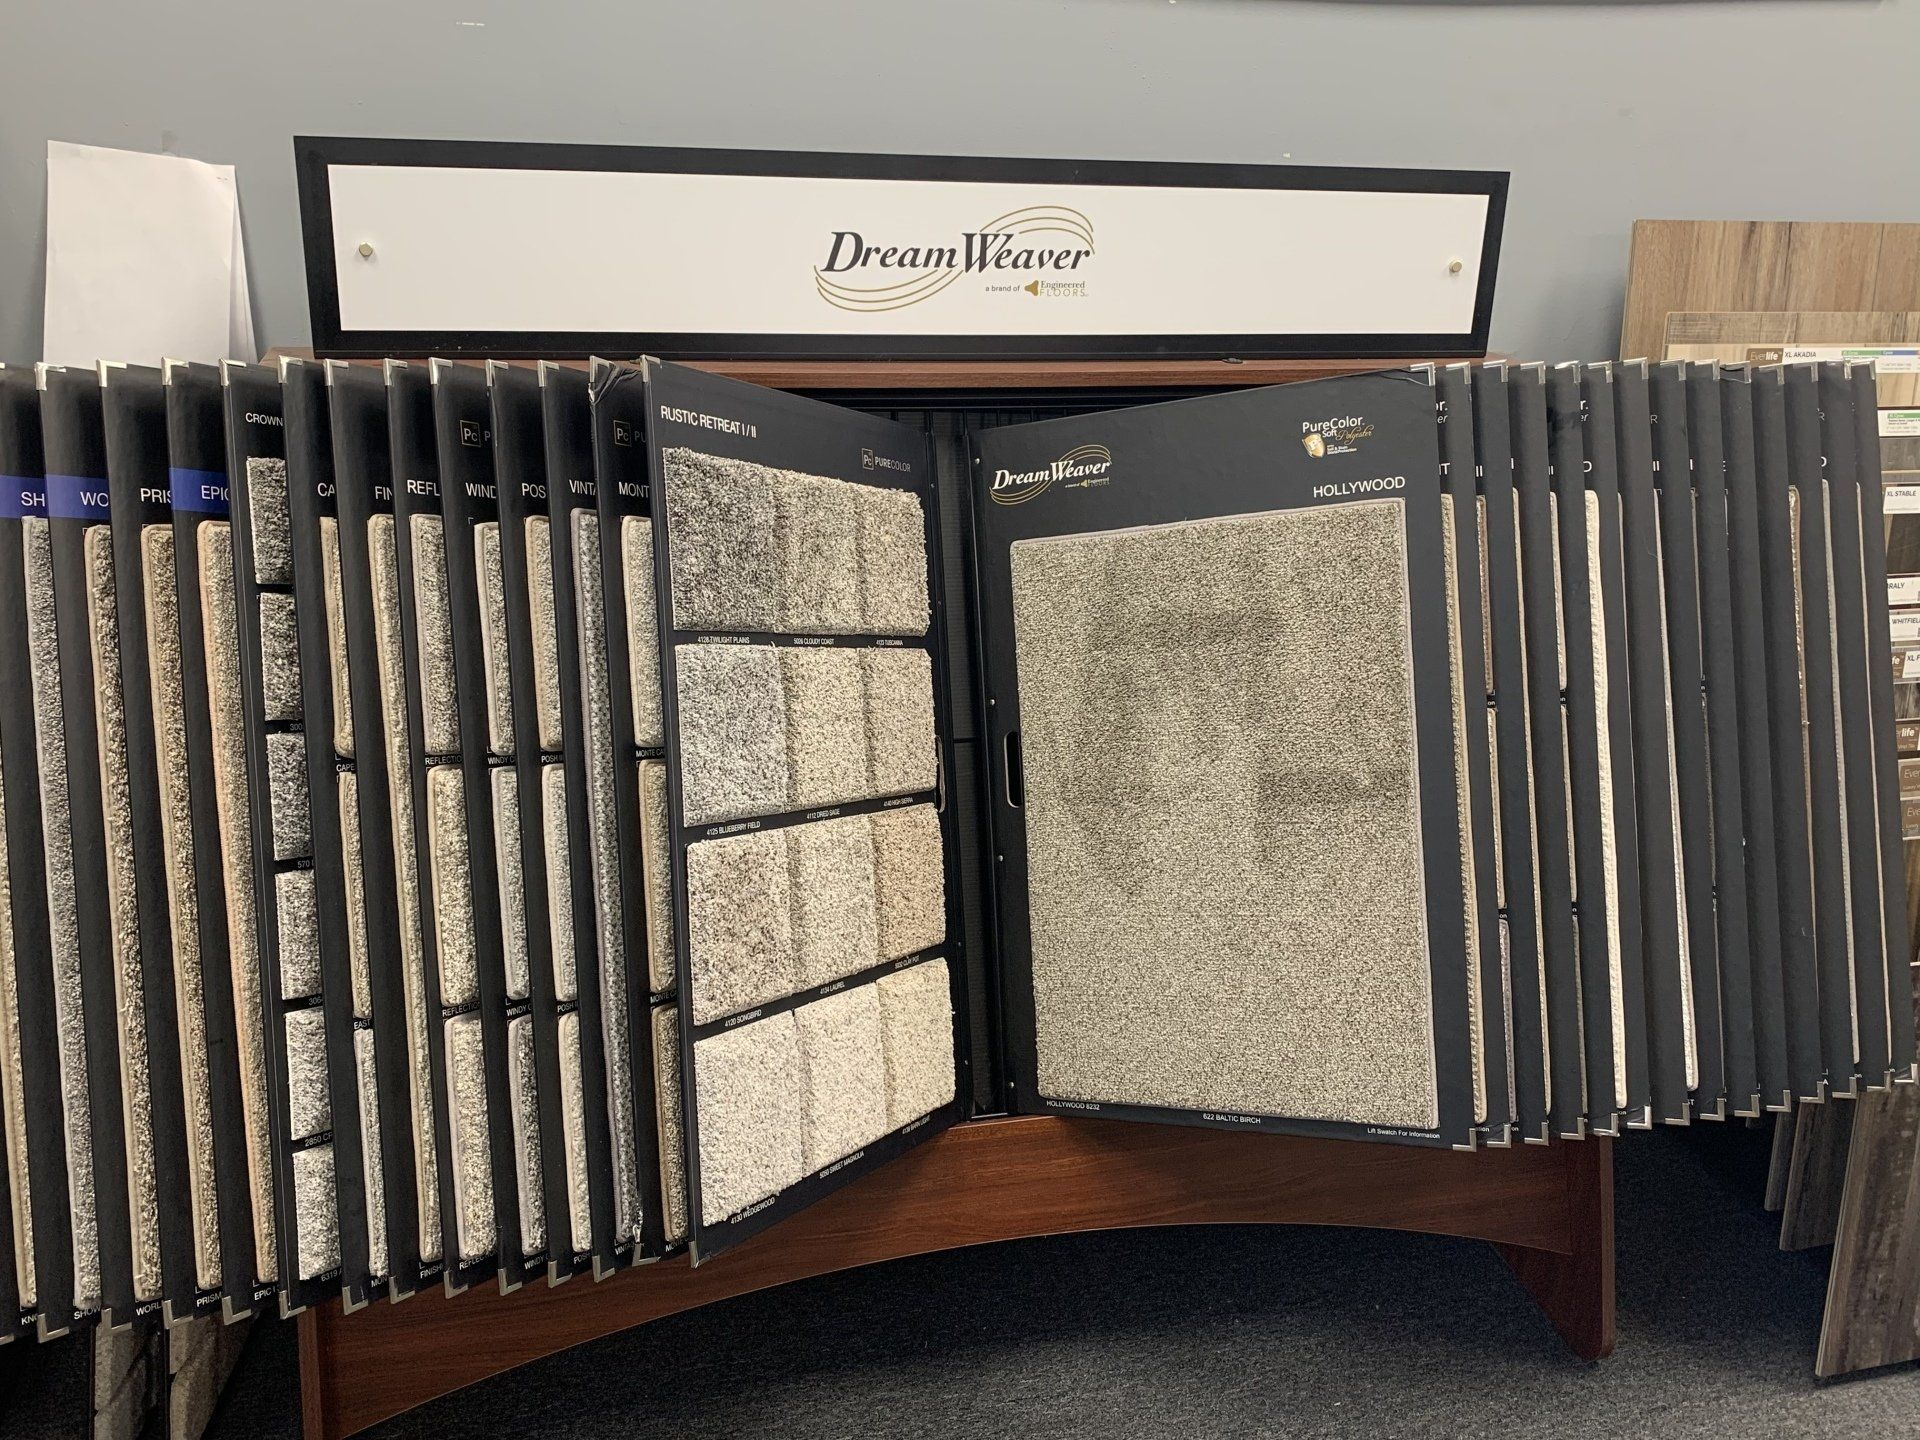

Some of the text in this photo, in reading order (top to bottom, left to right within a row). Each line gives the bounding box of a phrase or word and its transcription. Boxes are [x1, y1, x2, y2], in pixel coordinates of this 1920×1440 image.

[1041, 281, 1085, 290] Engineered
[1040, 289, 1085, 297] FLOORS
[245, 412, 284, 427] CROWN
[660, 405, 698, 426] RUSTIC
[700, 414, 740, 435] RETREAT
[875, 456, 911, 472] PURECOLOR
[1313, 476, 1405, 498] HOLLYWOOD
[733, 636, 750, 644] PLAINS
[804, 637, 820, 645] CLOUDY
[541, 754, 558, 763] POSH
[636, 749, 655, 757] MONTE
[488, 755, 509, 765] WINDY
[336, 763, 355, 772] CAPE
[719, 823, 747, 834] BLUEBERRY
[747, 820, 760, 830] FIELD
[829, 981, 845, 992] LAUREL
[650, 991, 670, 1003] MONTE
[506, 1004, 526, 1016] WINDY
[557, 1002, 574, 1012] POSH
[737, 1009, 762, 1023] SONGBIRD
[1046, 1100, 1085, 1109] HOLLYWOOD
[1215, 1114, 1239, 1122] BALTIC
[1240, 1116, 1260, 1124] BIRCH
[1377, 1128, 1397, 1136] Swatch
[1409, 1131, 1440, 1139] Information
[830, 1160, 843, 1174] SWEET
[843, 1150, 865, 1166] MAGNOLIA
[743, 1196, 776, 1219] WEDGEWOOD
[524, 1256, 543, 1270] WINDY
[254, 1287, 271, 1300] EPIC
[196, 1292, 222, 1307] PRISM
